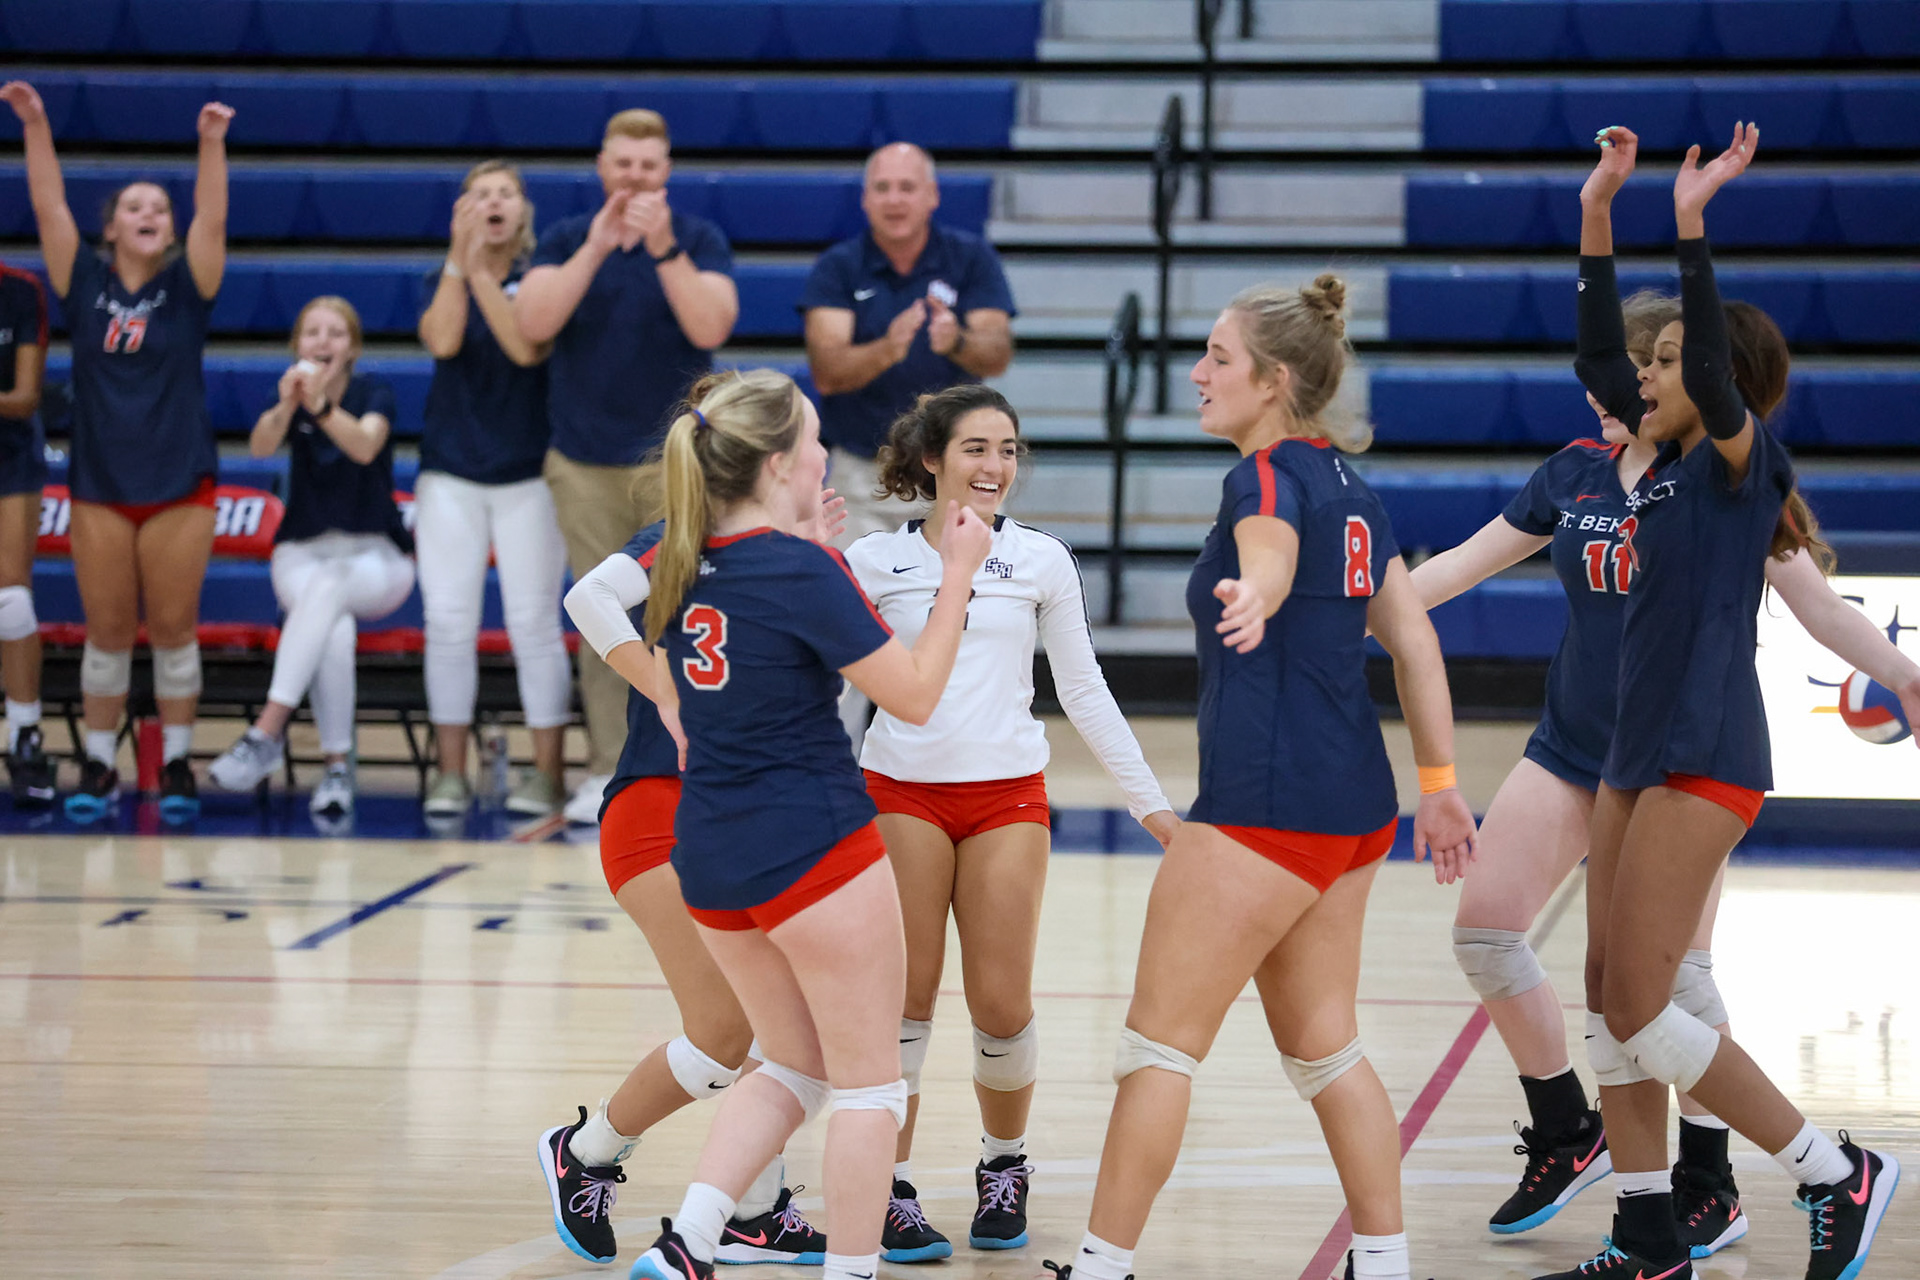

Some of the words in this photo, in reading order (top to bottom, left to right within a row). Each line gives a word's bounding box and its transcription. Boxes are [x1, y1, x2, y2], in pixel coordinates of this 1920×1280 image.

[1344, 516, 1374, 598] 8
[1582, 540, 1633, 595] 11
[682, 603, 729, 691] 3
